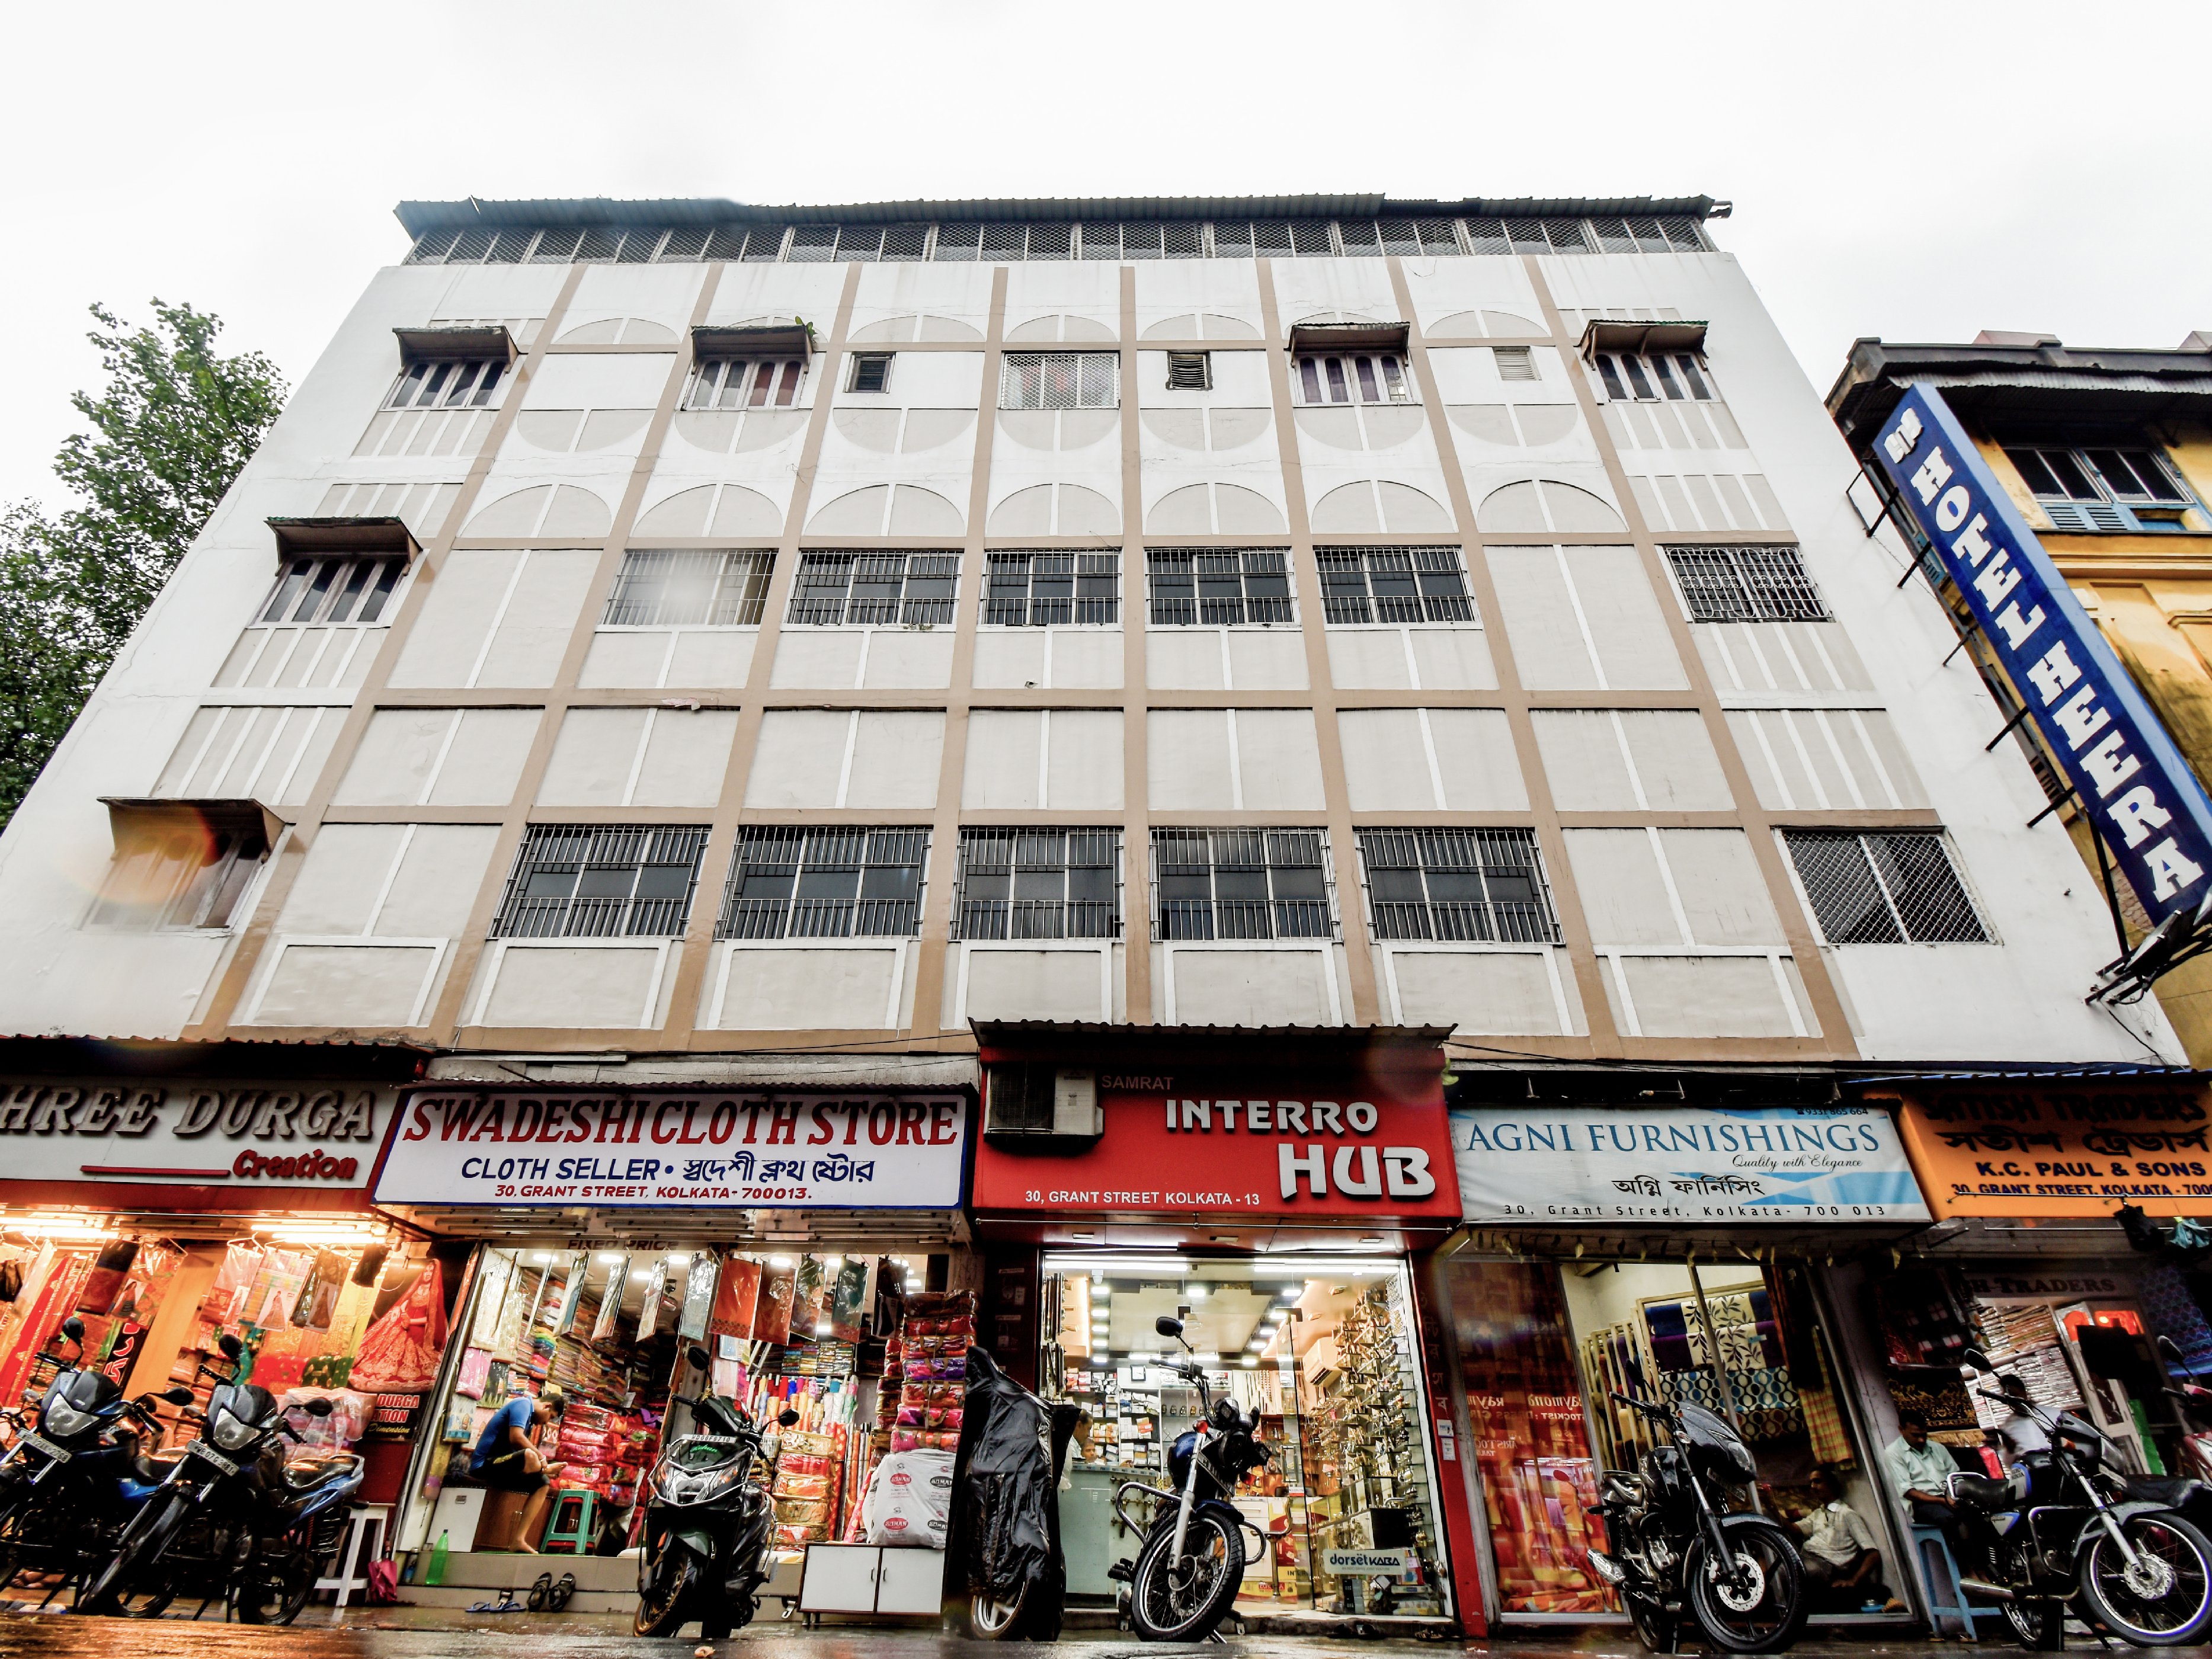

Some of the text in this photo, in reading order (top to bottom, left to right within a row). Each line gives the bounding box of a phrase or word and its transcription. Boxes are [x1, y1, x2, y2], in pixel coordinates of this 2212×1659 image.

[1910, 444, 2204, 904] HOTEL HEERA
[1101, 1075, 1174, 1091] SAMRAT
[174, 1088, 376, 1138] DURGA
[1166, 1099, 1379, 1135] INTERRO
[2045, 1094, 2207, 1123] TRADERS
[404, 1098, 958, 1146] SWADESHI CLOTH STORE
[1467, 1124, 1880, 1152] AGNI FURNISHINGS
[233, 1148, 358, 1178] Creation
[462, 1158, 664, 1181] CLOTH SELLER
[1732, 1154, 1863, 1171] Quality with Elegance
[1976, 1162, 2206, 1177] K.C. PAUL & SONS
[1278, 1143, 1437, 1202] HUB
[495, 1184, 518, 1198] 30,
[520, 1185, 578, 1197] GRANT
[581, 1186, 649, 1199] STREET,
[1611, 1175, 1662, 1197] অগ্নি
[1979, 1184, 2031, 1194] GRANT
[2101, 1185, 2173, 1196] KOLKATA
[1025, 1190, 1045, 1205] 30,
[1049, 1191, 1099, 1203] GRANT
[1103, 1192, 1160, 1204] STREET
[1166, 1193, 1233, 1205] KOLKATA
[1244, 1194, 1260, 1205] 13
[1504, 1205, 1534, 1216] 30,
[1548, 1205, 1603, 1216] Grant
[1615, 1205, 1691, 1218] Street,
[567, 1240, 680, 1251] FIXED PRICE
[1993, 1277, 2117, 1293] TRADERS
[376, 1393, 421, 1408] DURGA
[368, 1423, 410, 1433] Dimension
